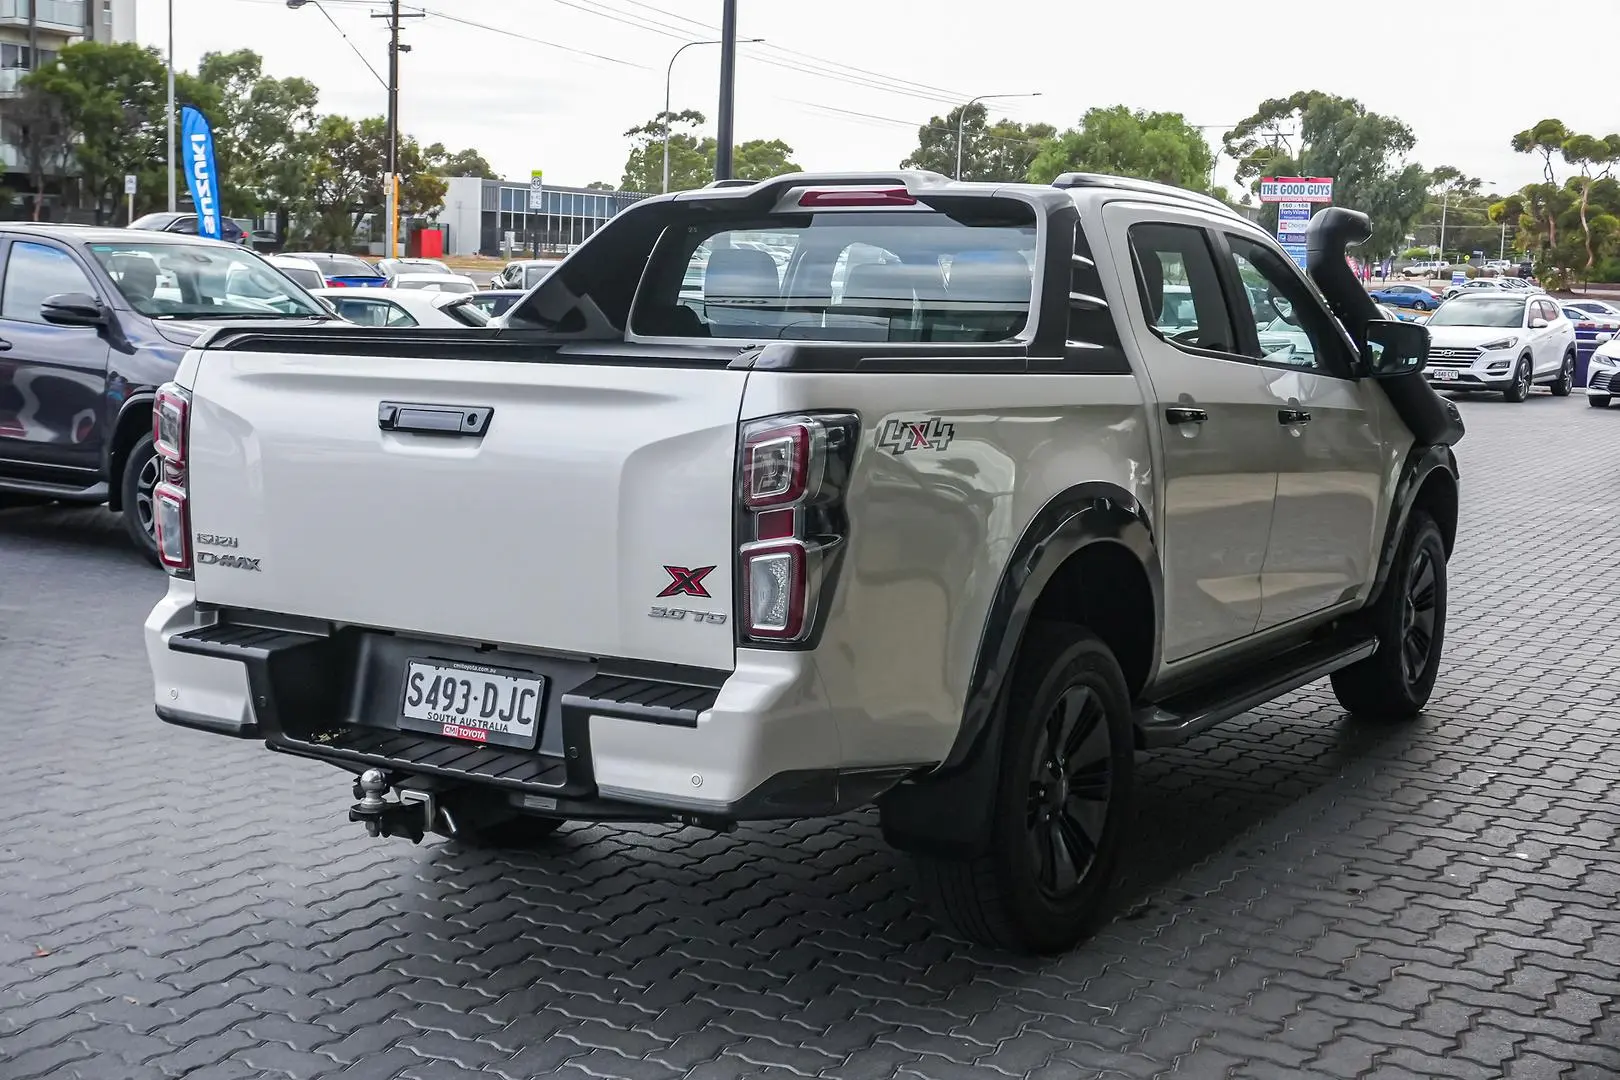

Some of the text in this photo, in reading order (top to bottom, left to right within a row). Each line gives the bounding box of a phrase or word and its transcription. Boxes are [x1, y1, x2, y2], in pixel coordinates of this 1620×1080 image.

[1262, 184, 1330, 196] THE GOOD GUYS
[196, 533, 238, 548] ISUZU
[196, 551, 262, 572] D-MAX
[453, 663, 497, 673] cmitoyota.com.au
[427, 711, 509, 732] SOUTH AUSTRALIA
[443, 725, 486, 740] CMI TOYOTA
